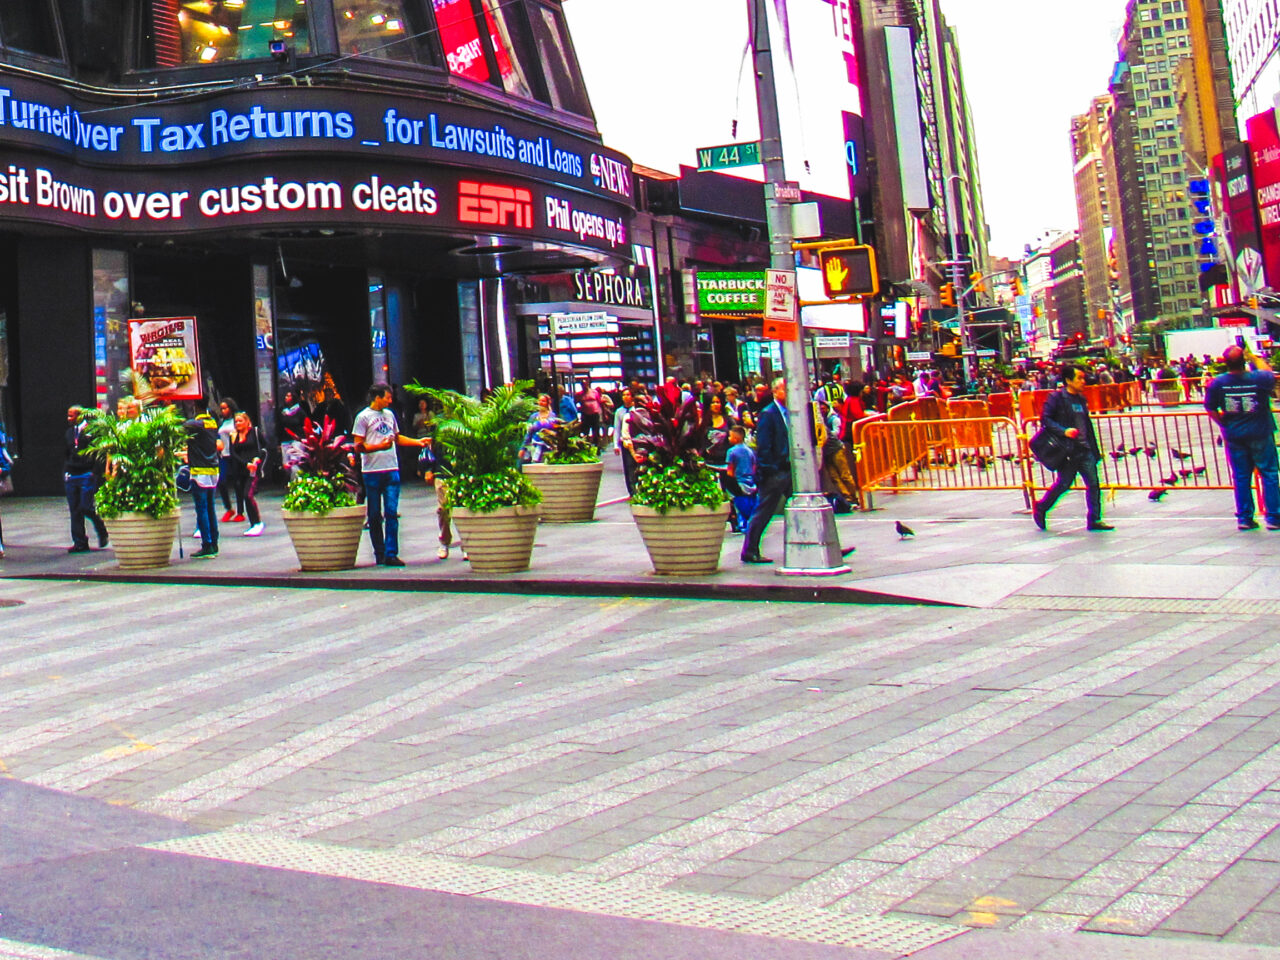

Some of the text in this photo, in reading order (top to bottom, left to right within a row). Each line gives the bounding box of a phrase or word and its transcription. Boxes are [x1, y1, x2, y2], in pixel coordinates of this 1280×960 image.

[132, 117, 206, 153] Tax
[211, 105, 354, 147] Returns
[383, 107, 423, 145] for
[429, 113, 516, 161] Lawsuits
[518, 136, 546, 167] and
[546, 139, 584, 179] Loans
[699, 144, 755, 168] W 44 ST
[35, 167, 96, 217] Brown
[103, 190, 189, 220] over
[198, 177, 343, 218] custom
[351, 175, 438, 215] cleats
[458, 179, 534, 229] ESPN
[545, 195, 572, 232] Phil
[571, 208, 605, 241] opens
[604, 218, 617, 248] up
[575, 271, 643, 306] SEPHORA
[697, 278, 765, 290] TARBUCK
[775, 273, 787, 285] NO
[706, 293, 758, 304] COFFEE
